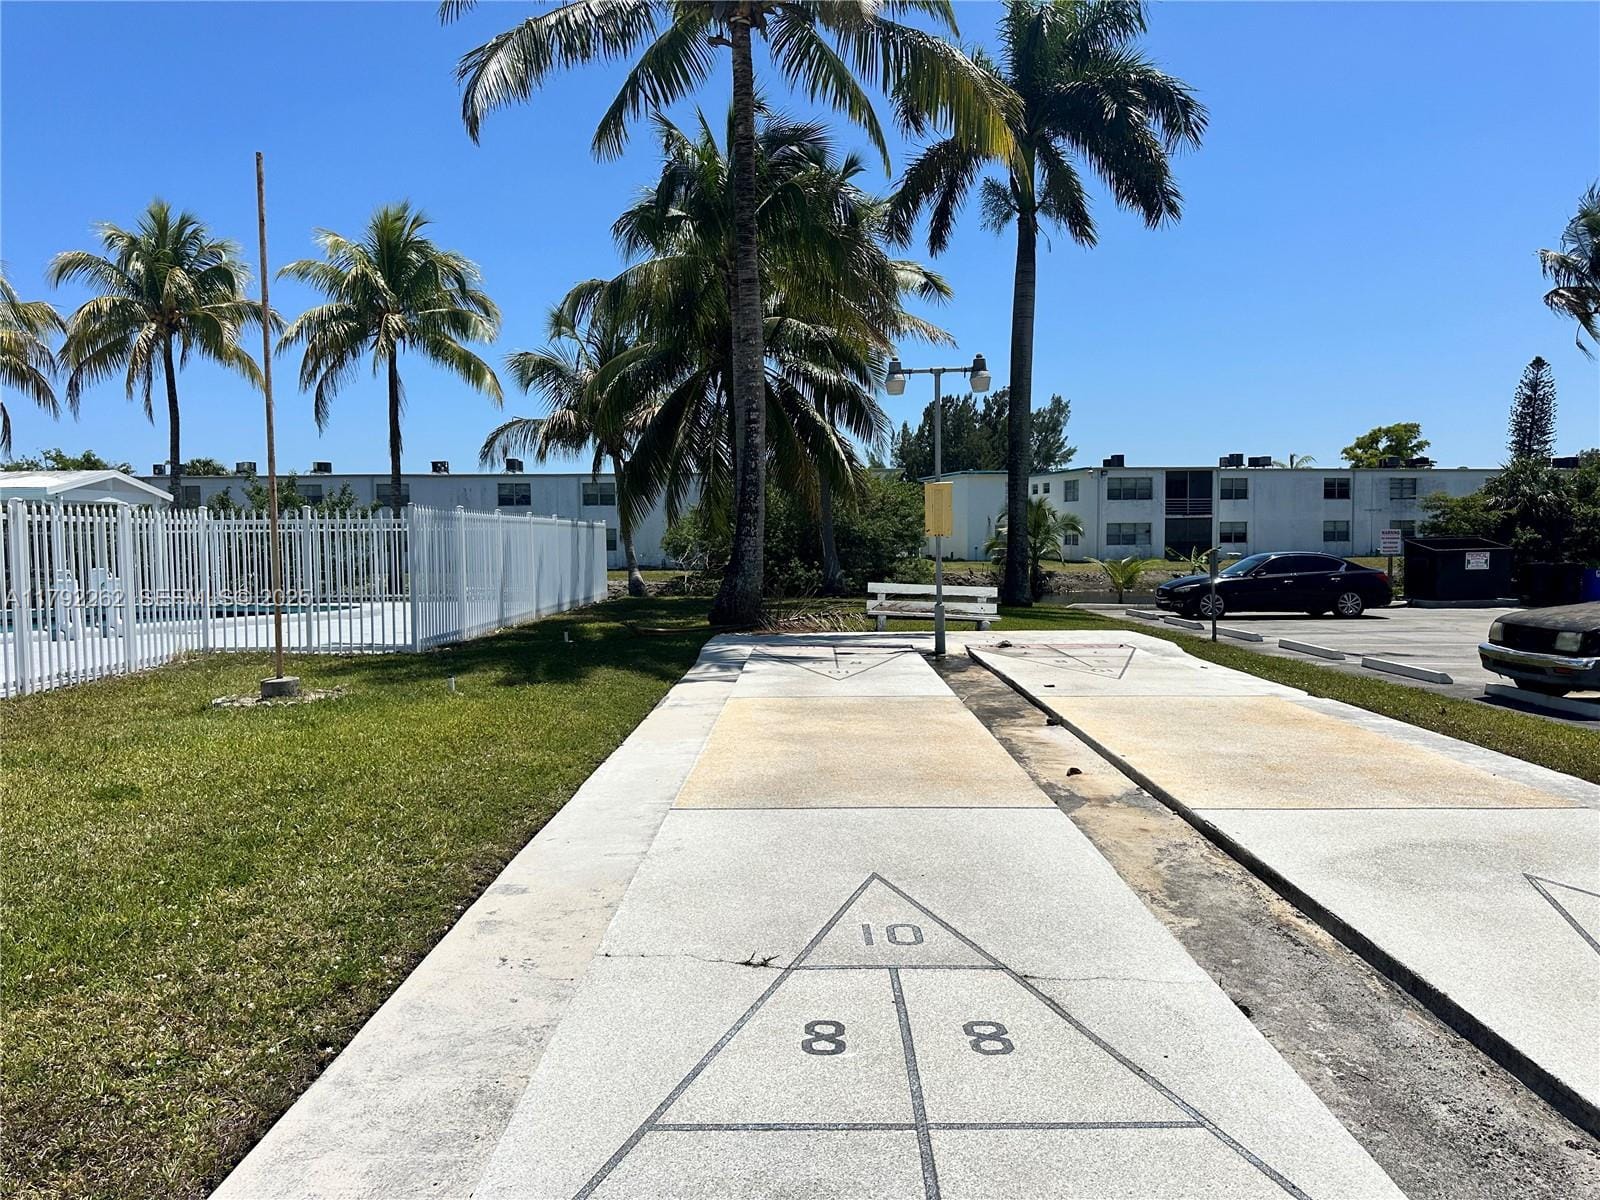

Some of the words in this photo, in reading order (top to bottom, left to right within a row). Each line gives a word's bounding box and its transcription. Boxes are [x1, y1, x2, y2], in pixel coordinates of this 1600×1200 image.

[862, 923, 924, 946] 10
[801, 1019, 847, 1056] 8
[961, 1020, 1016, 1056] 8
